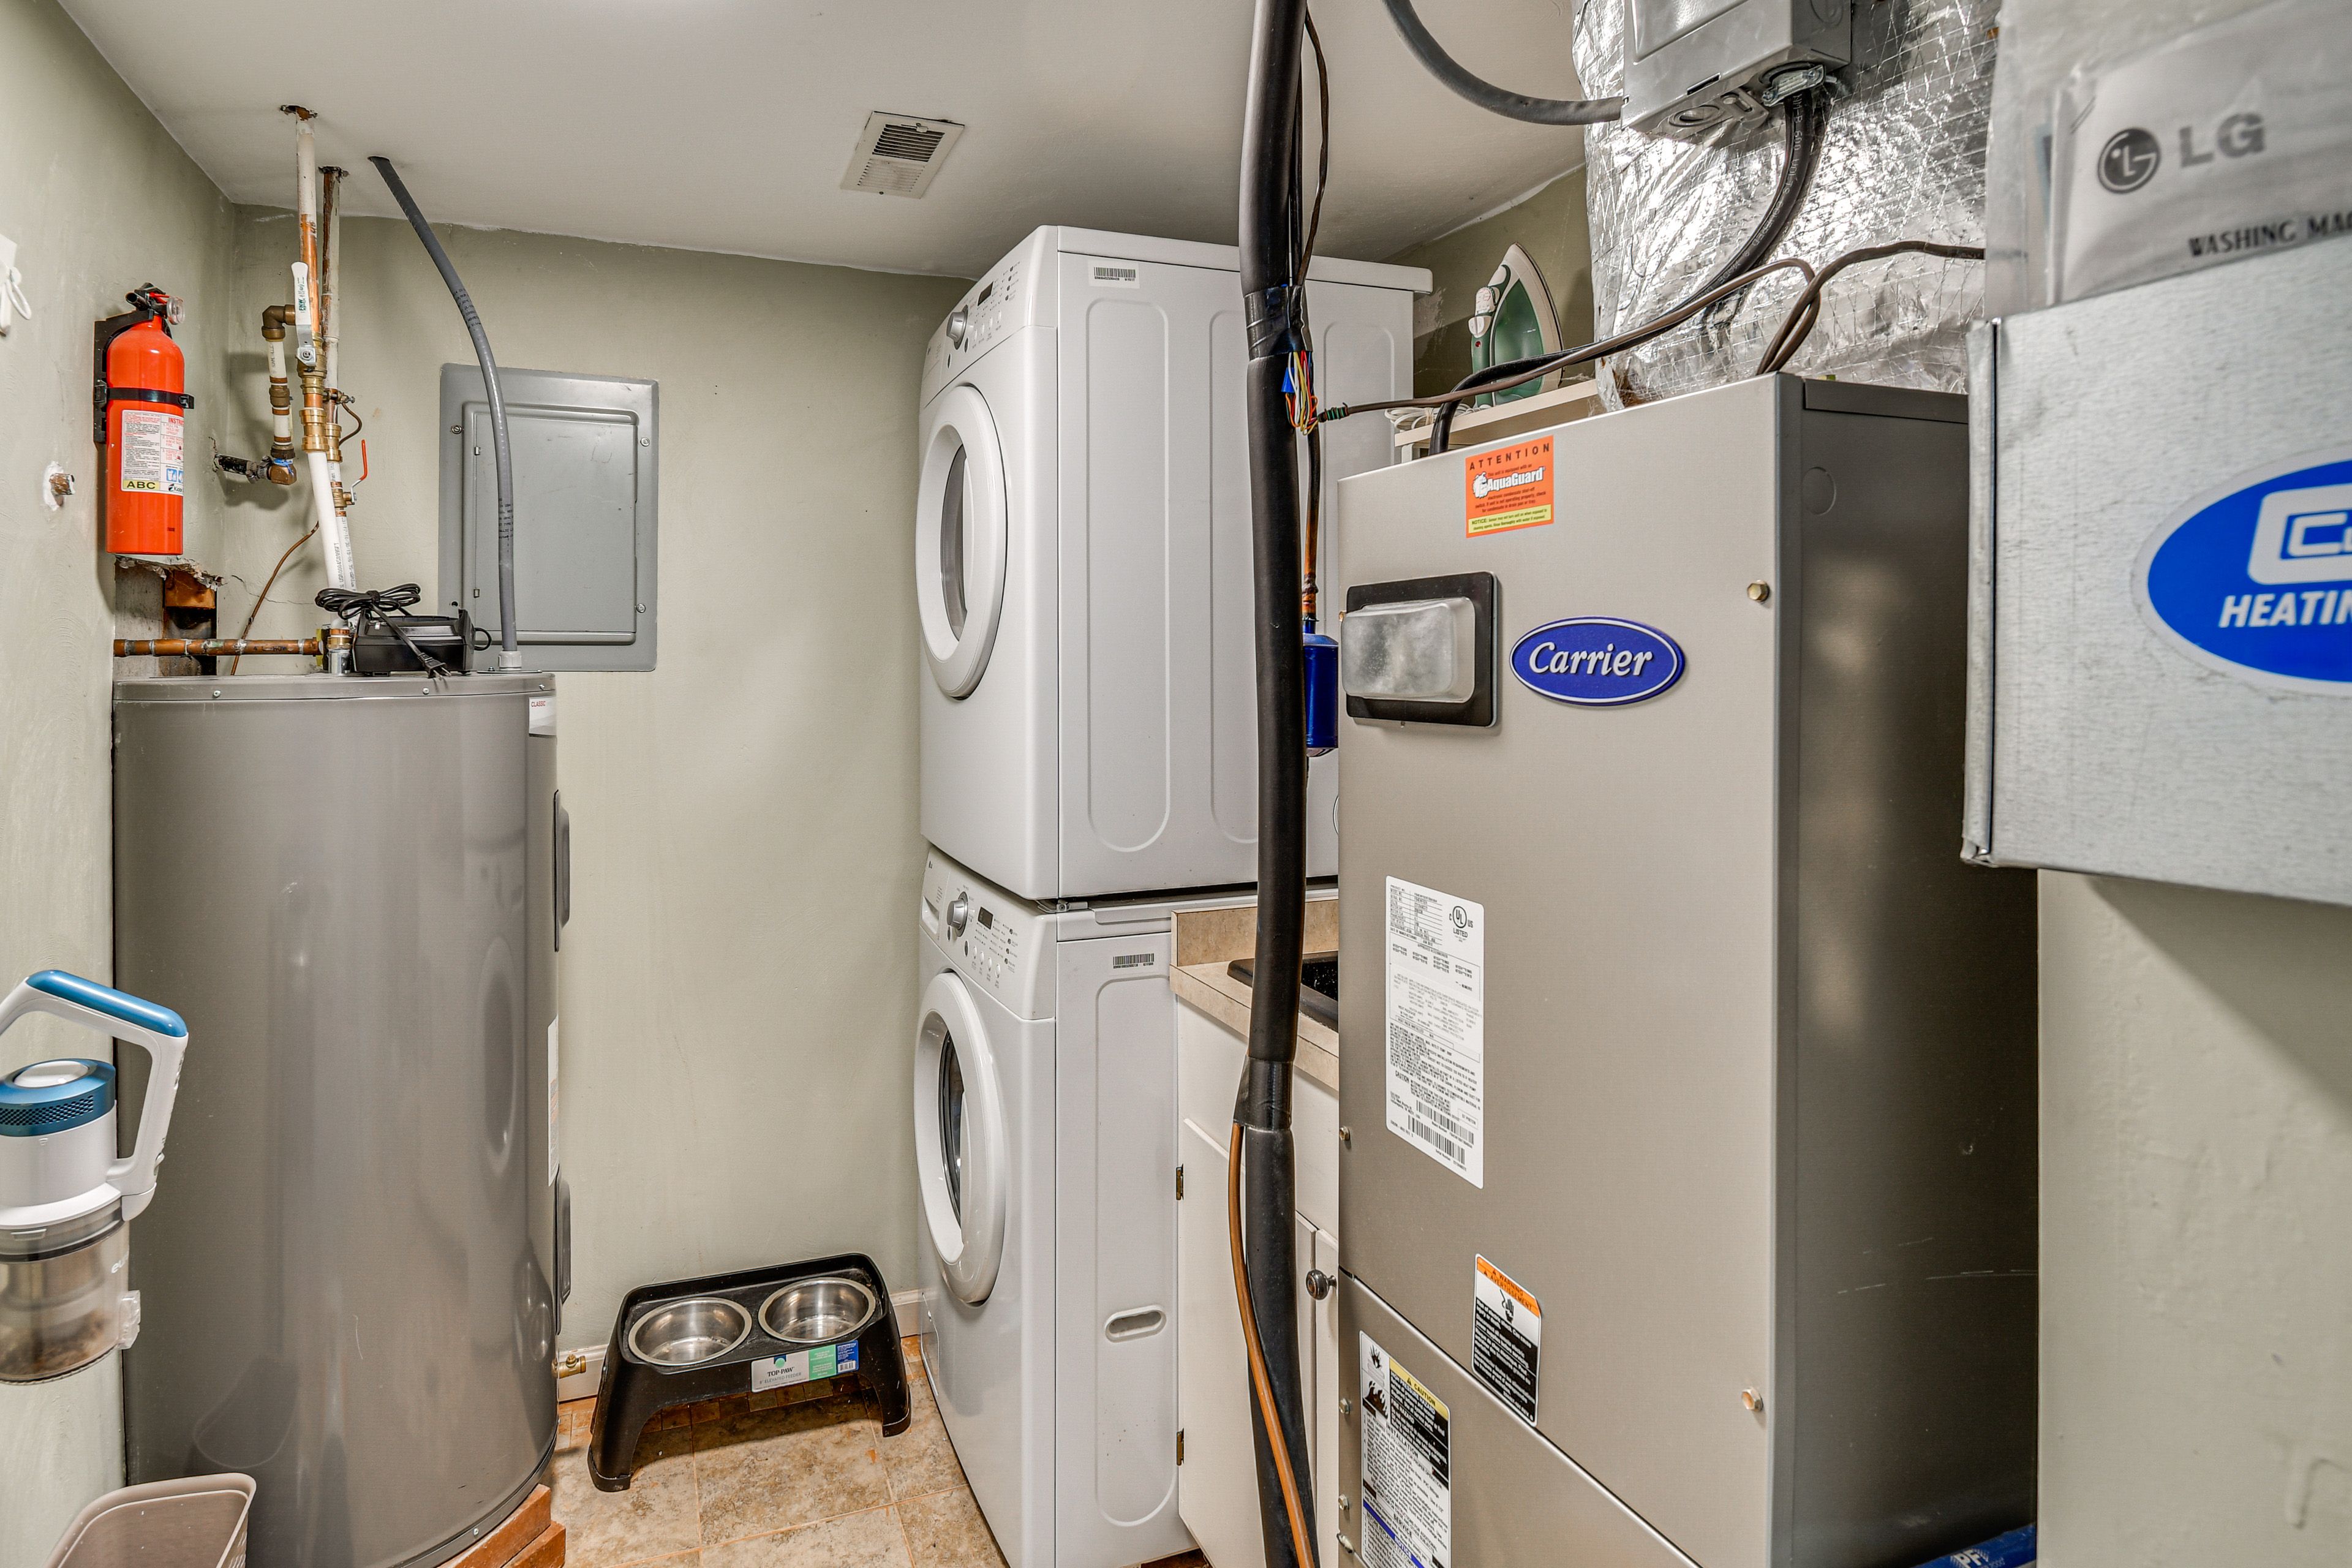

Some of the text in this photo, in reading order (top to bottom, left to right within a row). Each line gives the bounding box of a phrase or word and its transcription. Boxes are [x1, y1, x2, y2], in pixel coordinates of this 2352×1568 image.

[2179, 113, 2266, 168] LG
[2188, 219, 2296, 257] WASHING
[1469, 442, 1549, 470] ATTENTION
[127, 481, 156, 489] ABC
[1488, 466, 1543, 492] AquaGuard
[1529, 641, 1653, 676] Carrier
[1453, 928, 1468, 938] LISTED
[1499, 1273, 1523, 1295] WARNING
[1414, 1382, 1435, 1407] CAUTION
[1386, 1422, 1418, 1459] INSTALLATION
